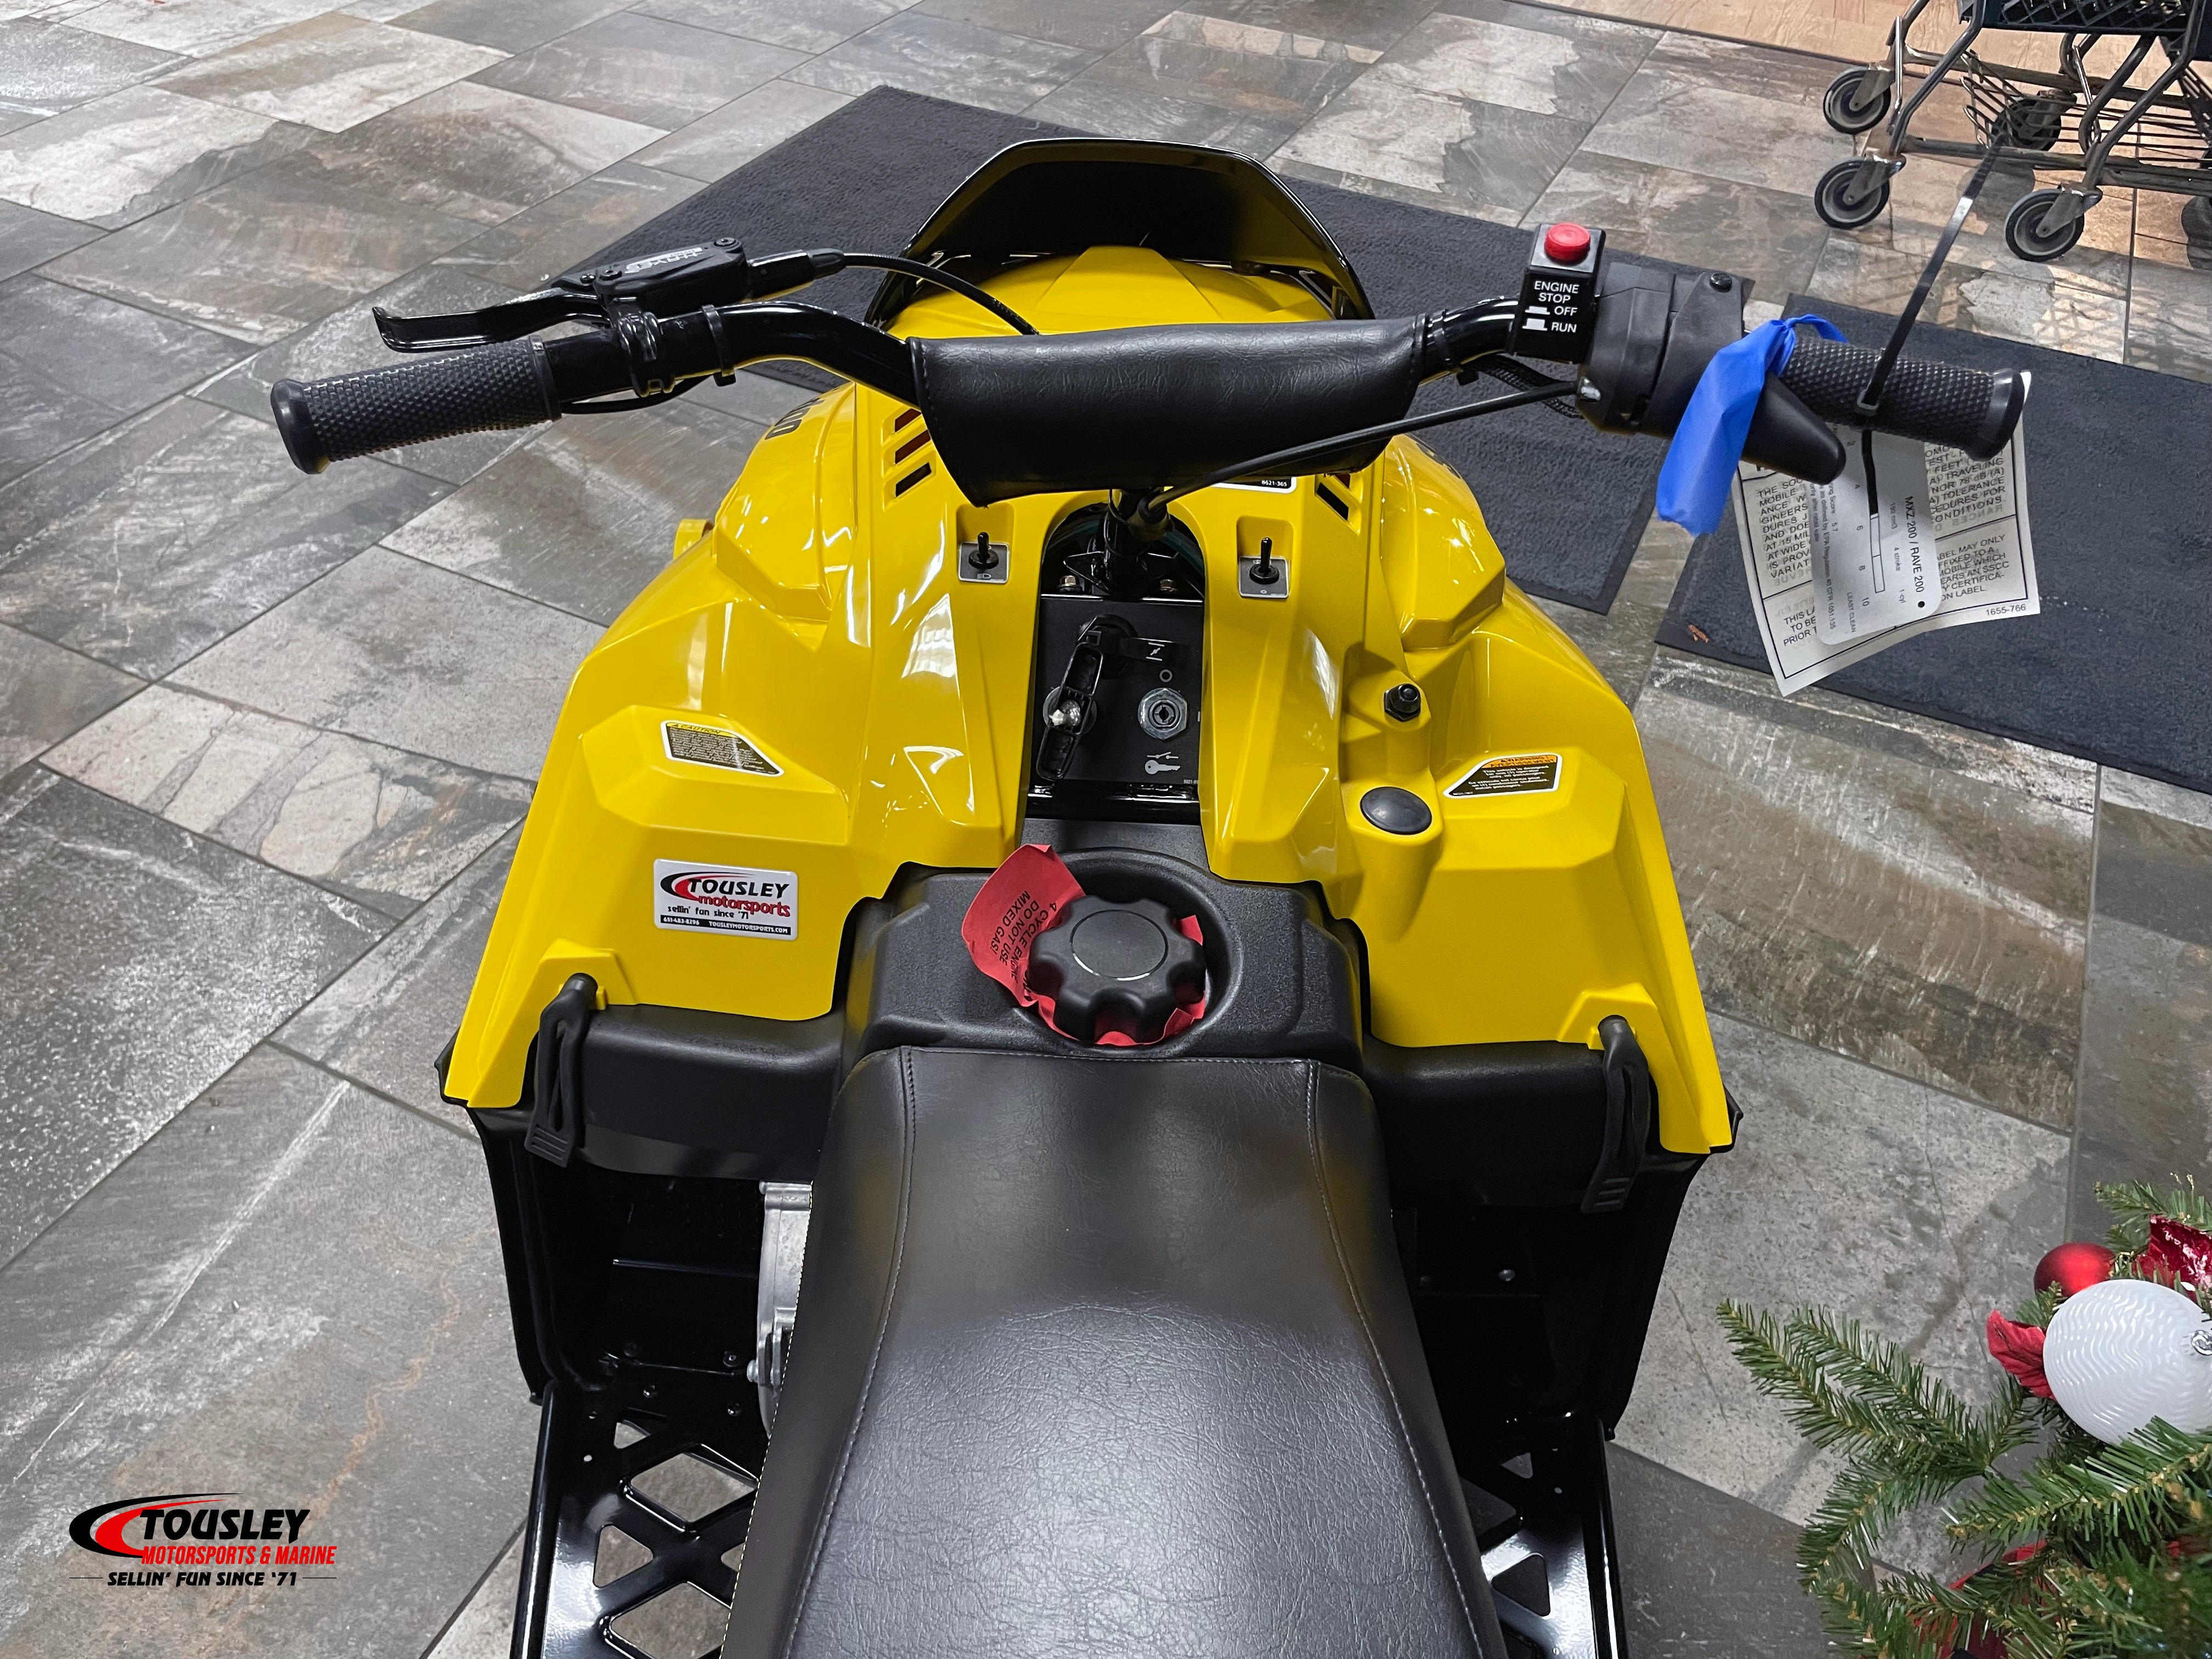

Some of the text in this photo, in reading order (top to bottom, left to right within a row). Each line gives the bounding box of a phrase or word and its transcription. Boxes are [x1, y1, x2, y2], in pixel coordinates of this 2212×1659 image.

[1534, 281, 1579, 294] ENGINE
[1538, 293, 1571, 303] STOP
[1554, 306, 1578, 316] OFF
[1551, 322, 1577, 333] RUN
[1934, 460, 1961, 474] FEET
[1946, 458, 2003, 481] TRAVELING
[1758, 486, 1778, 498] THE
[1932, 481, 1955, 494] NOR
[1943, 476, 2005, 501] TOLERANCE
[1983, 486, 2006, 498] FOR
[1759, 487, 1796, 507] MOBILE
[1760, 501, 1788, 516] ANCE
[1761, 503, 1808, 524] GINEERS
[1905, 496, 1915, 520] MXZ
[1763, 517, 1797, 533] DURES
[1907, 521, 1917, 539] 200
[1764, 530, 1785, 543] AND
[1959, 541, 1978, 554] MAY
[1980, 534, 2005, 546] ONLY
[1766, 542, 1776, 552] AT
[1768, 541, 1807, 561] AT WIDE
[1769, 549, 1809, 570] IS PROV
[1910, 547, 1922, 574] RAVE
[1973, 552, 2006, 566] WHICH
[1770, 558, 1809, 578] VARIAT
[1940, 561, 2010, 584] EARS AN SSCC
[1914, 575, 1925, 592] 200
[1951, 571, 2005, 589] CERTIFICA-
[1862, 597, 1870, 607] 10
[1985, 603, 2026, 616] 1655-766
[1784, 612, 1804, 625] THIS
[1790, 616, 1816, 633] TO BE
[1784, 629, 1811, 646] PRIOR
[680, 725, 720, 734] CAUTION
[687, 878, 789, 899] TOUSLEY
[668, 906, 691, 914] sellin'
[695, 907, 709, 916] fun
[714, 909, 734, 918] since
[698, 895, 791, 917] motorsports
[709, 921, 788, 933] TOUSLEYMOTORSPORTS.COM
[990, 891, 1031, 955] MIXED GAS!
[1000, 900, 1040, 966] DO NOT USE
[1011, 902, 1057, 984] 4 CYCLE ENGINE
